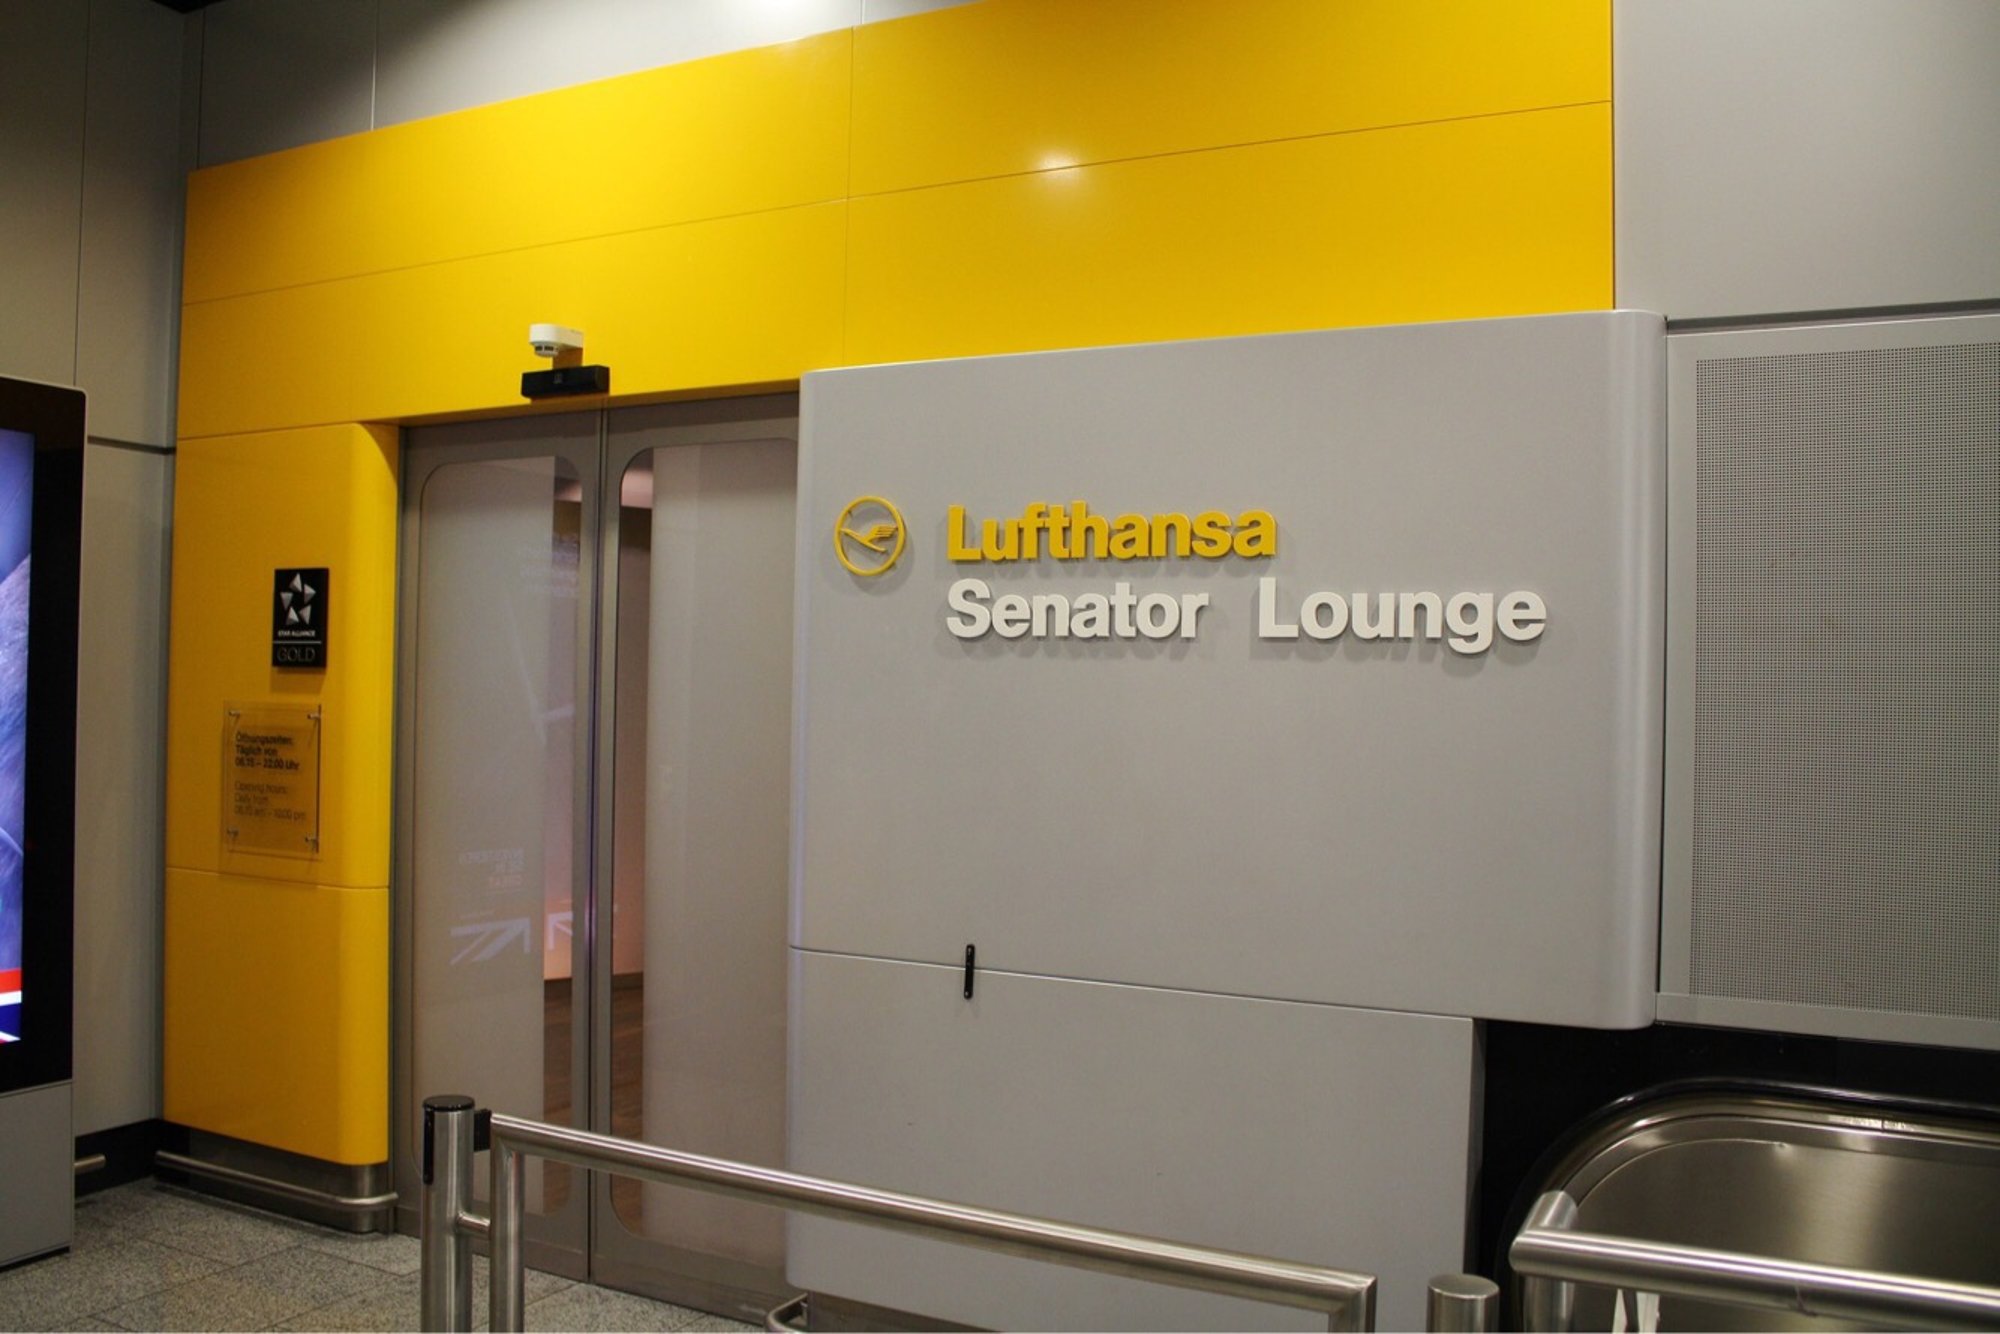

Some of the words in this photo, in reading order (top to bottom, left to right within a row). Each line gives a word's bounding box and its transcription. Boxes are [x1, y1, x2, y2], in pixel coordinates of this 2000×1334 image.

[947, 501, 1277, 562] Lufthansa
[946, 578, 1210, 639] Senator
[1258, 576, 1547, 655] Lounge
[277, 647, 316, 662] GOLD
[285, 760, 300, 771] Uhr
